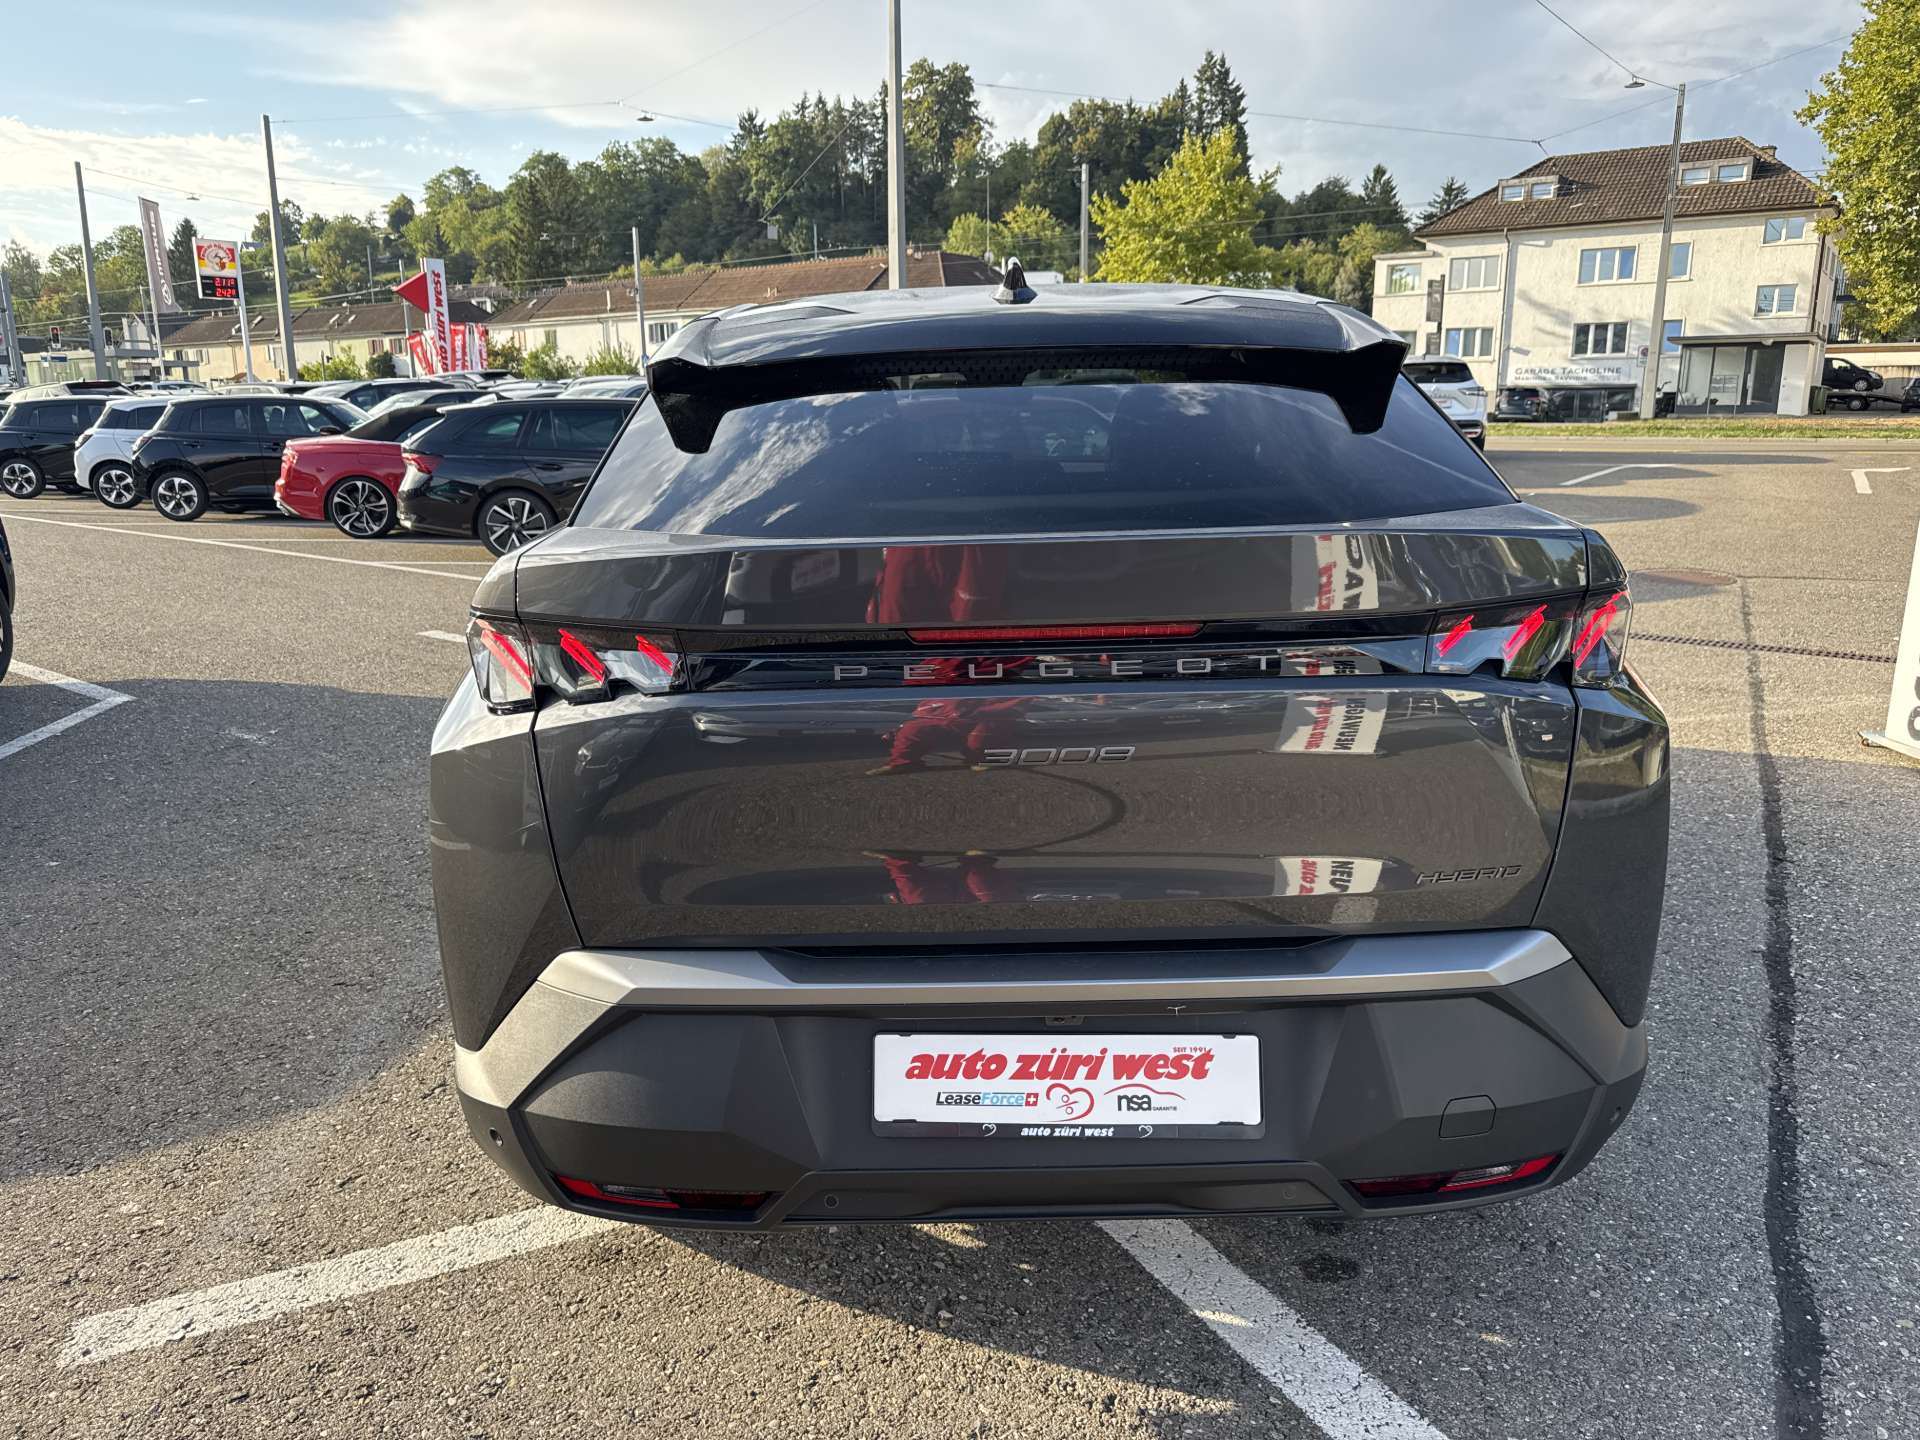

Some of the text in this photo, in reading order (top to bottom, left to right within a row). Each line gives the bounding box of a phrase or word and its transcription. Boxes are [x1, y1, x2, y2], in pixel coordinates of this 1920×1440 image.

[1514, 366, 1622, 376] GARAGE TACHOLINE
[834, 655, 1280, 681] PEUGEOT
[979, 746, 1136, 767] 3008
[1416, 865, 1523, 885] HYBRID
[905, 1047, 1215, 1081] auto züri west
[936, 1091, 1025, 1106] LeaseForce
[1117, 1094, 1152, 1111] nsa
[1020, 1126, 1115, 1137] auto züri west
